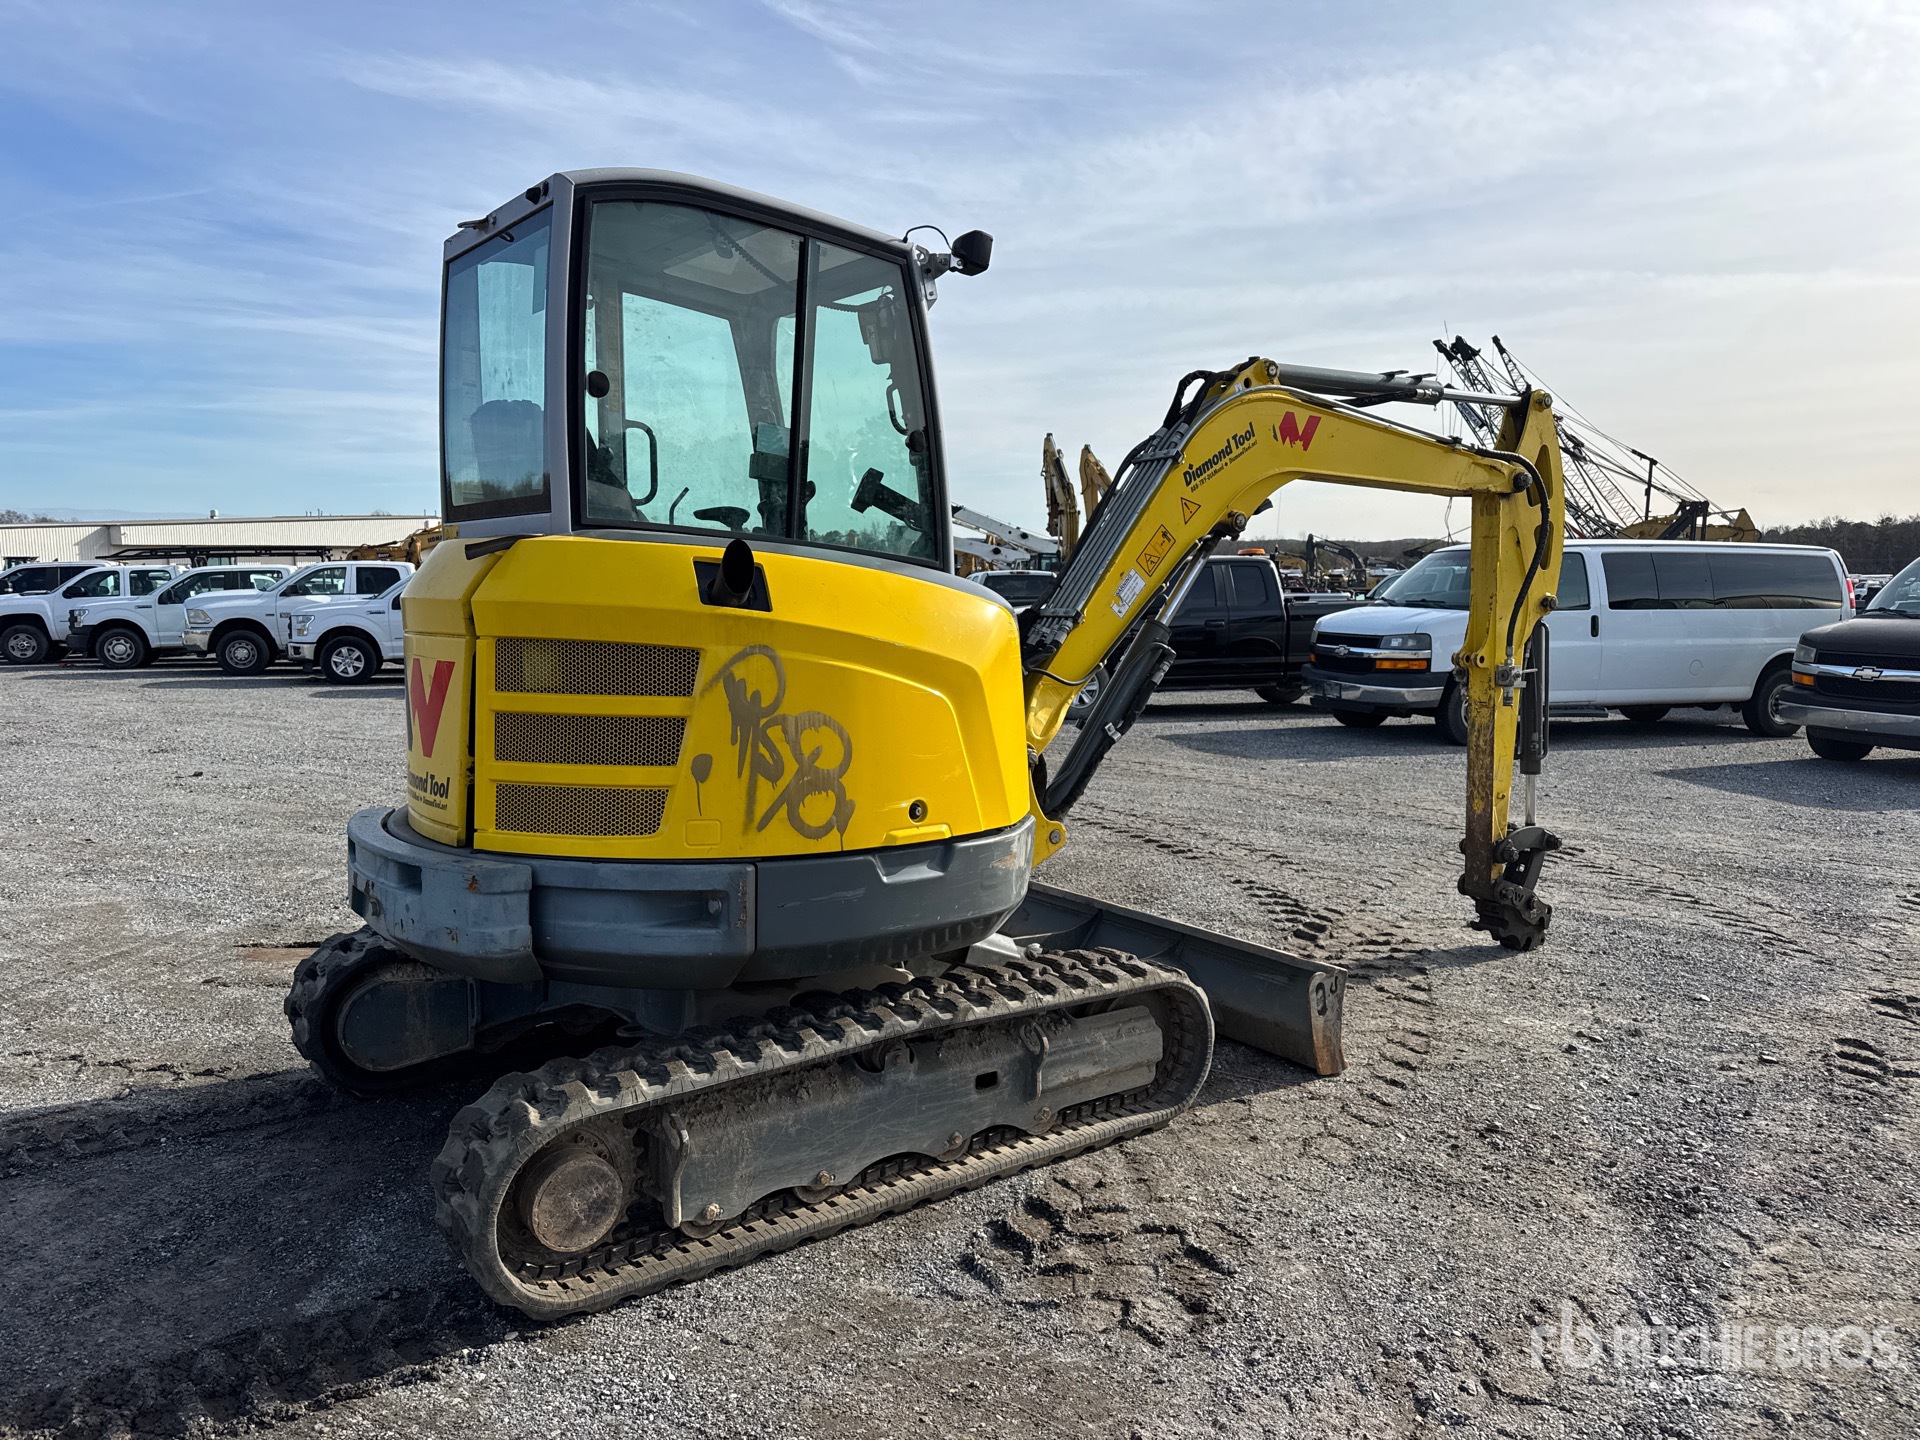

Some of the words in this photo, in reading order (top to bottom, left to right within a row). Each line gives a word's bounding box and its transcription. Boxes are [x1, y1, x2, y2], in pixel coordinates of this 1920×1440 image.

[1183, 438, 1233, 487] Diamond
[1231, 421, 1256, 450] Tool
[429, 773, 450, 799] Tool
